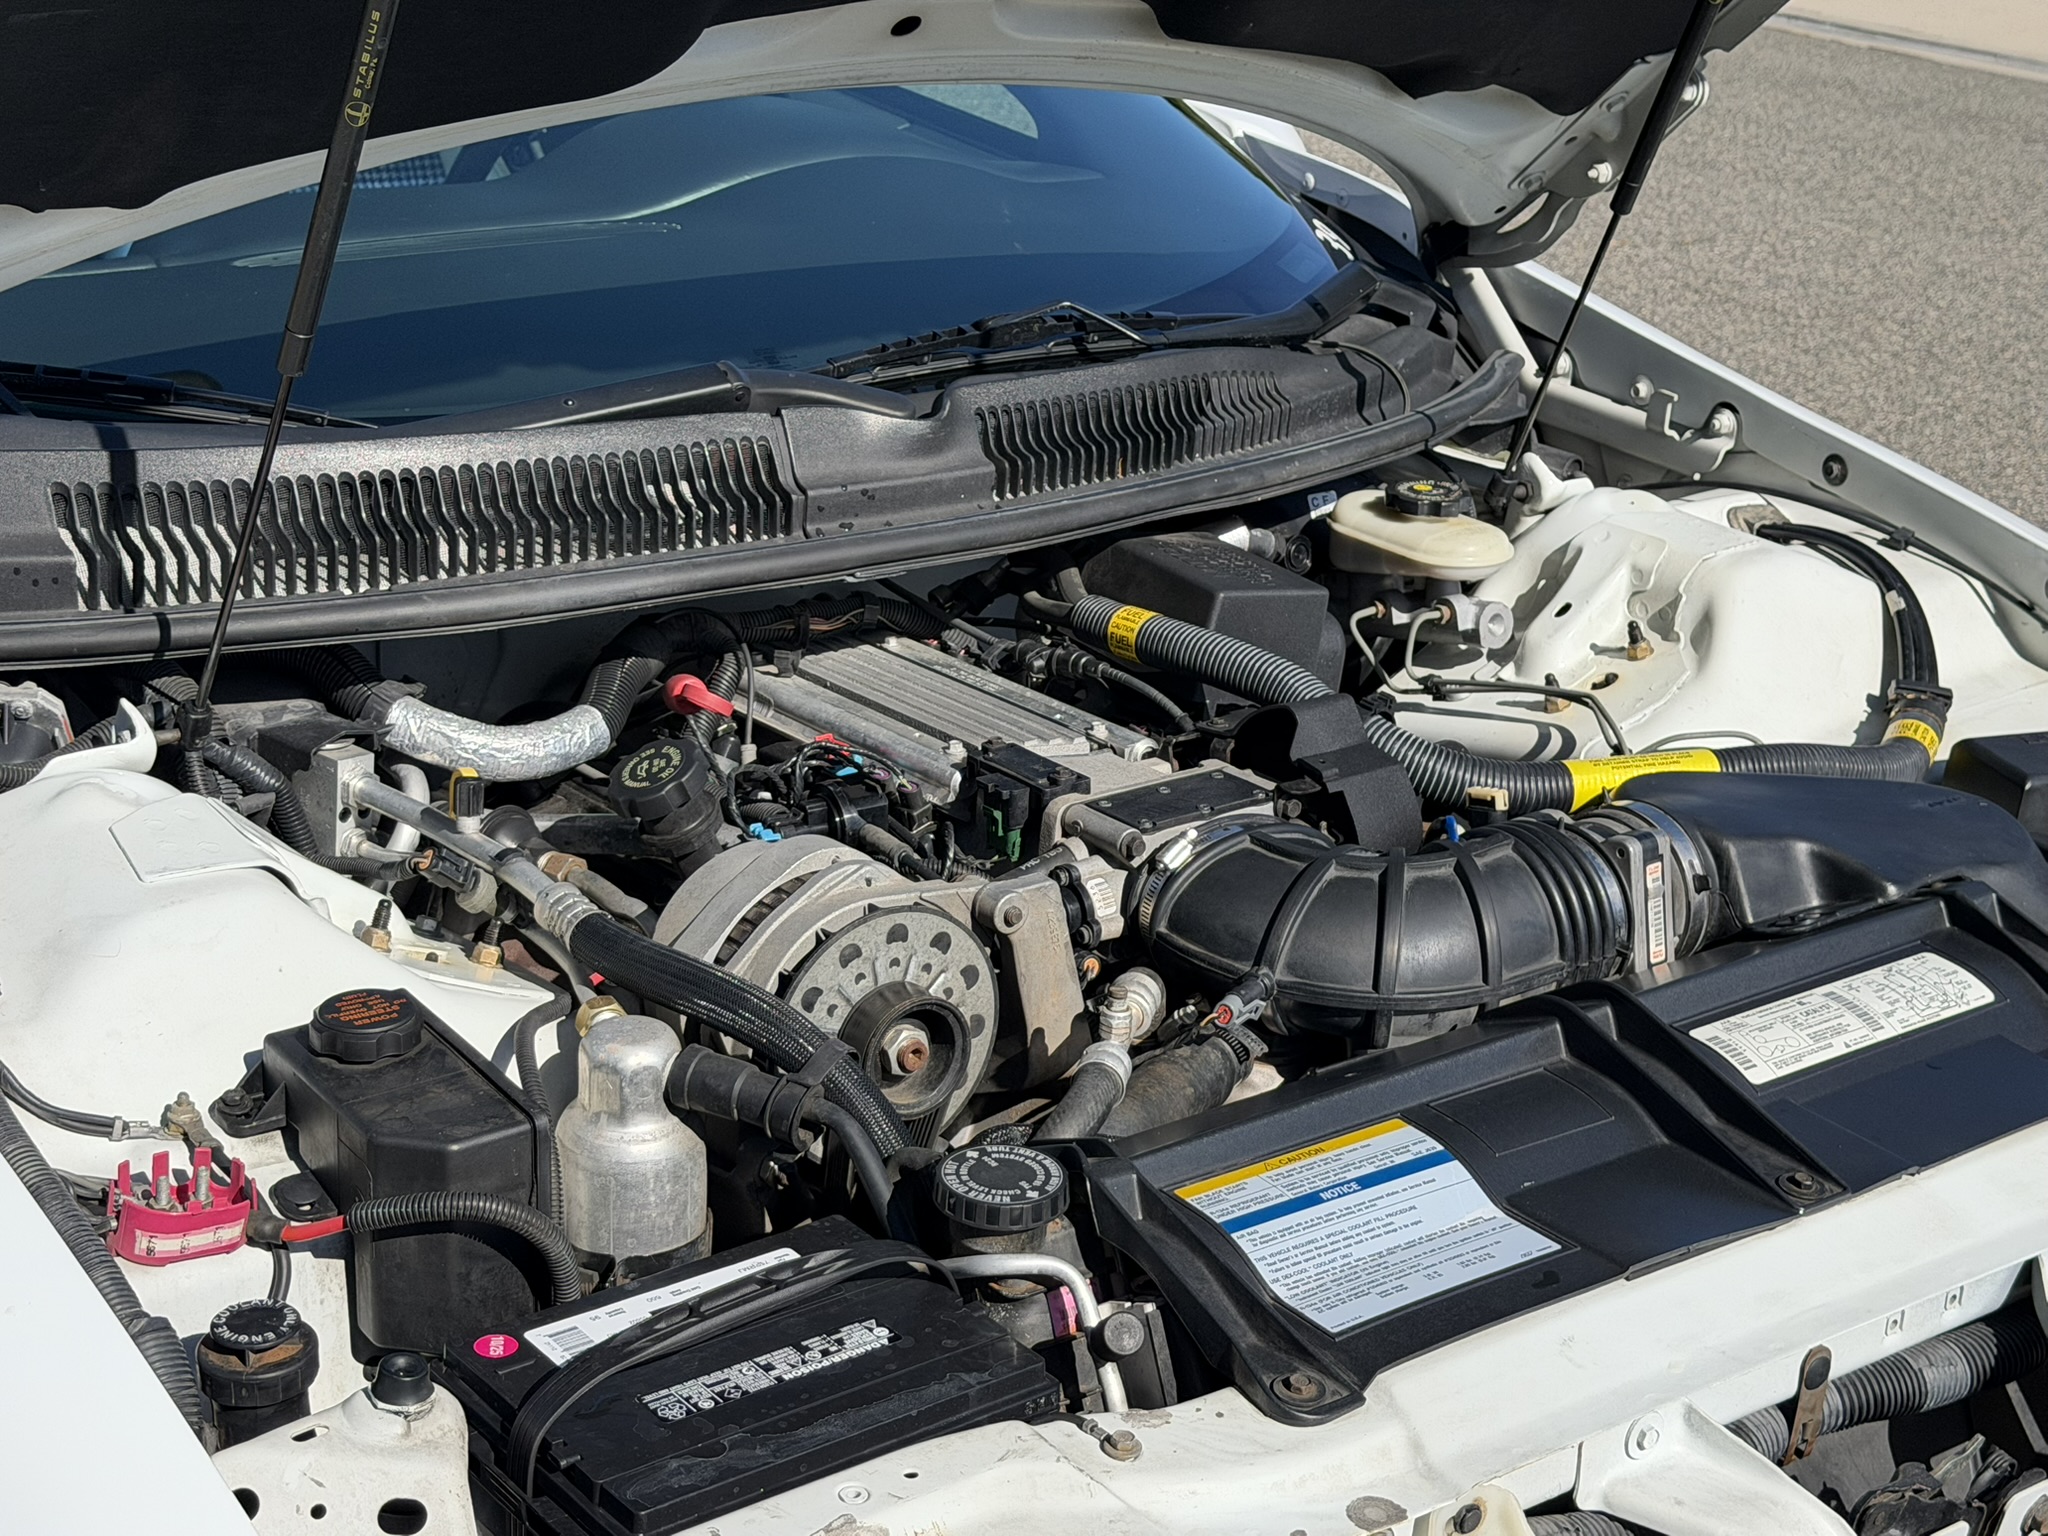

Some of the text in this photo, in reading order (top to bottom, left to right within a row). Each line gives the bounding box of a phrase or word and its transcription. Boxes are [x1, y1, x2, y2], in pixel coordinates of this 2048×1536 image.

[353, 10, 381, 98] STABILUS
[1121, 608, 1145, 620] FUEL
[1111, 621, 1135, 634] CAUTION
[1110, 632, 1132, 648] FUEL
[640, 748, 656, 758] SEE
[657, 745, 682, 778] ENGINE OIL
[335, 994, 380, 1008] APPROVED
[342, 992, 367, 1000] FLUID
[325, 1007, 367, 1019] OVERFILL
[340, 1004, 400, 1021] STEERING
[341, 1003, 362, 1011] ONLY
[373, 1002, 390, 1010] NOT
[353, 1013, 399, 1026] POWER
[991, 1153, 1025, 1162] SYSTEM
[1012, 1147, 1036, 1158] VENT
[1278, 1147, 1326, 1165] CAUTION
[944, 1160, 1011, 1203] NEVER OPEN HOT
[966, 1180, 989, 1193] LEVEL
[1319, 1182, 1361, 1200] NOTICE
[1214, 1193, 1285, 1220] UNDER HIGH PRESSURE
[1245, 1228, 1259, 1237] BAG
[1254, 1254, 1267, 1263] THIS
[1267, 1246, 1291, 1259] VEHICLE
[1291, 1237, 1319, 1251] REQUIRES
[1324, 1227, 1347, 1239] SPECIAL
[1348, 1218, 1372, 1232] COOLANT
[1373, 1215, 1384, 1223] FILL
[1385, 1203, 1417, 1219] PROCEDURE
[1268, 1275, 1282, 1285] USE
[1312, 1256, 1338, 1269] COOLANT
[1339, 1251, 1353, 1260] ONLY
[213, 1299, 285, 1324] COOLANT
[213, 1325, 277, 1343] ENGINE
[488, 1336, 504, 1356] 10/25
[782, 1341, 881, 1381] DANGER/POISON
